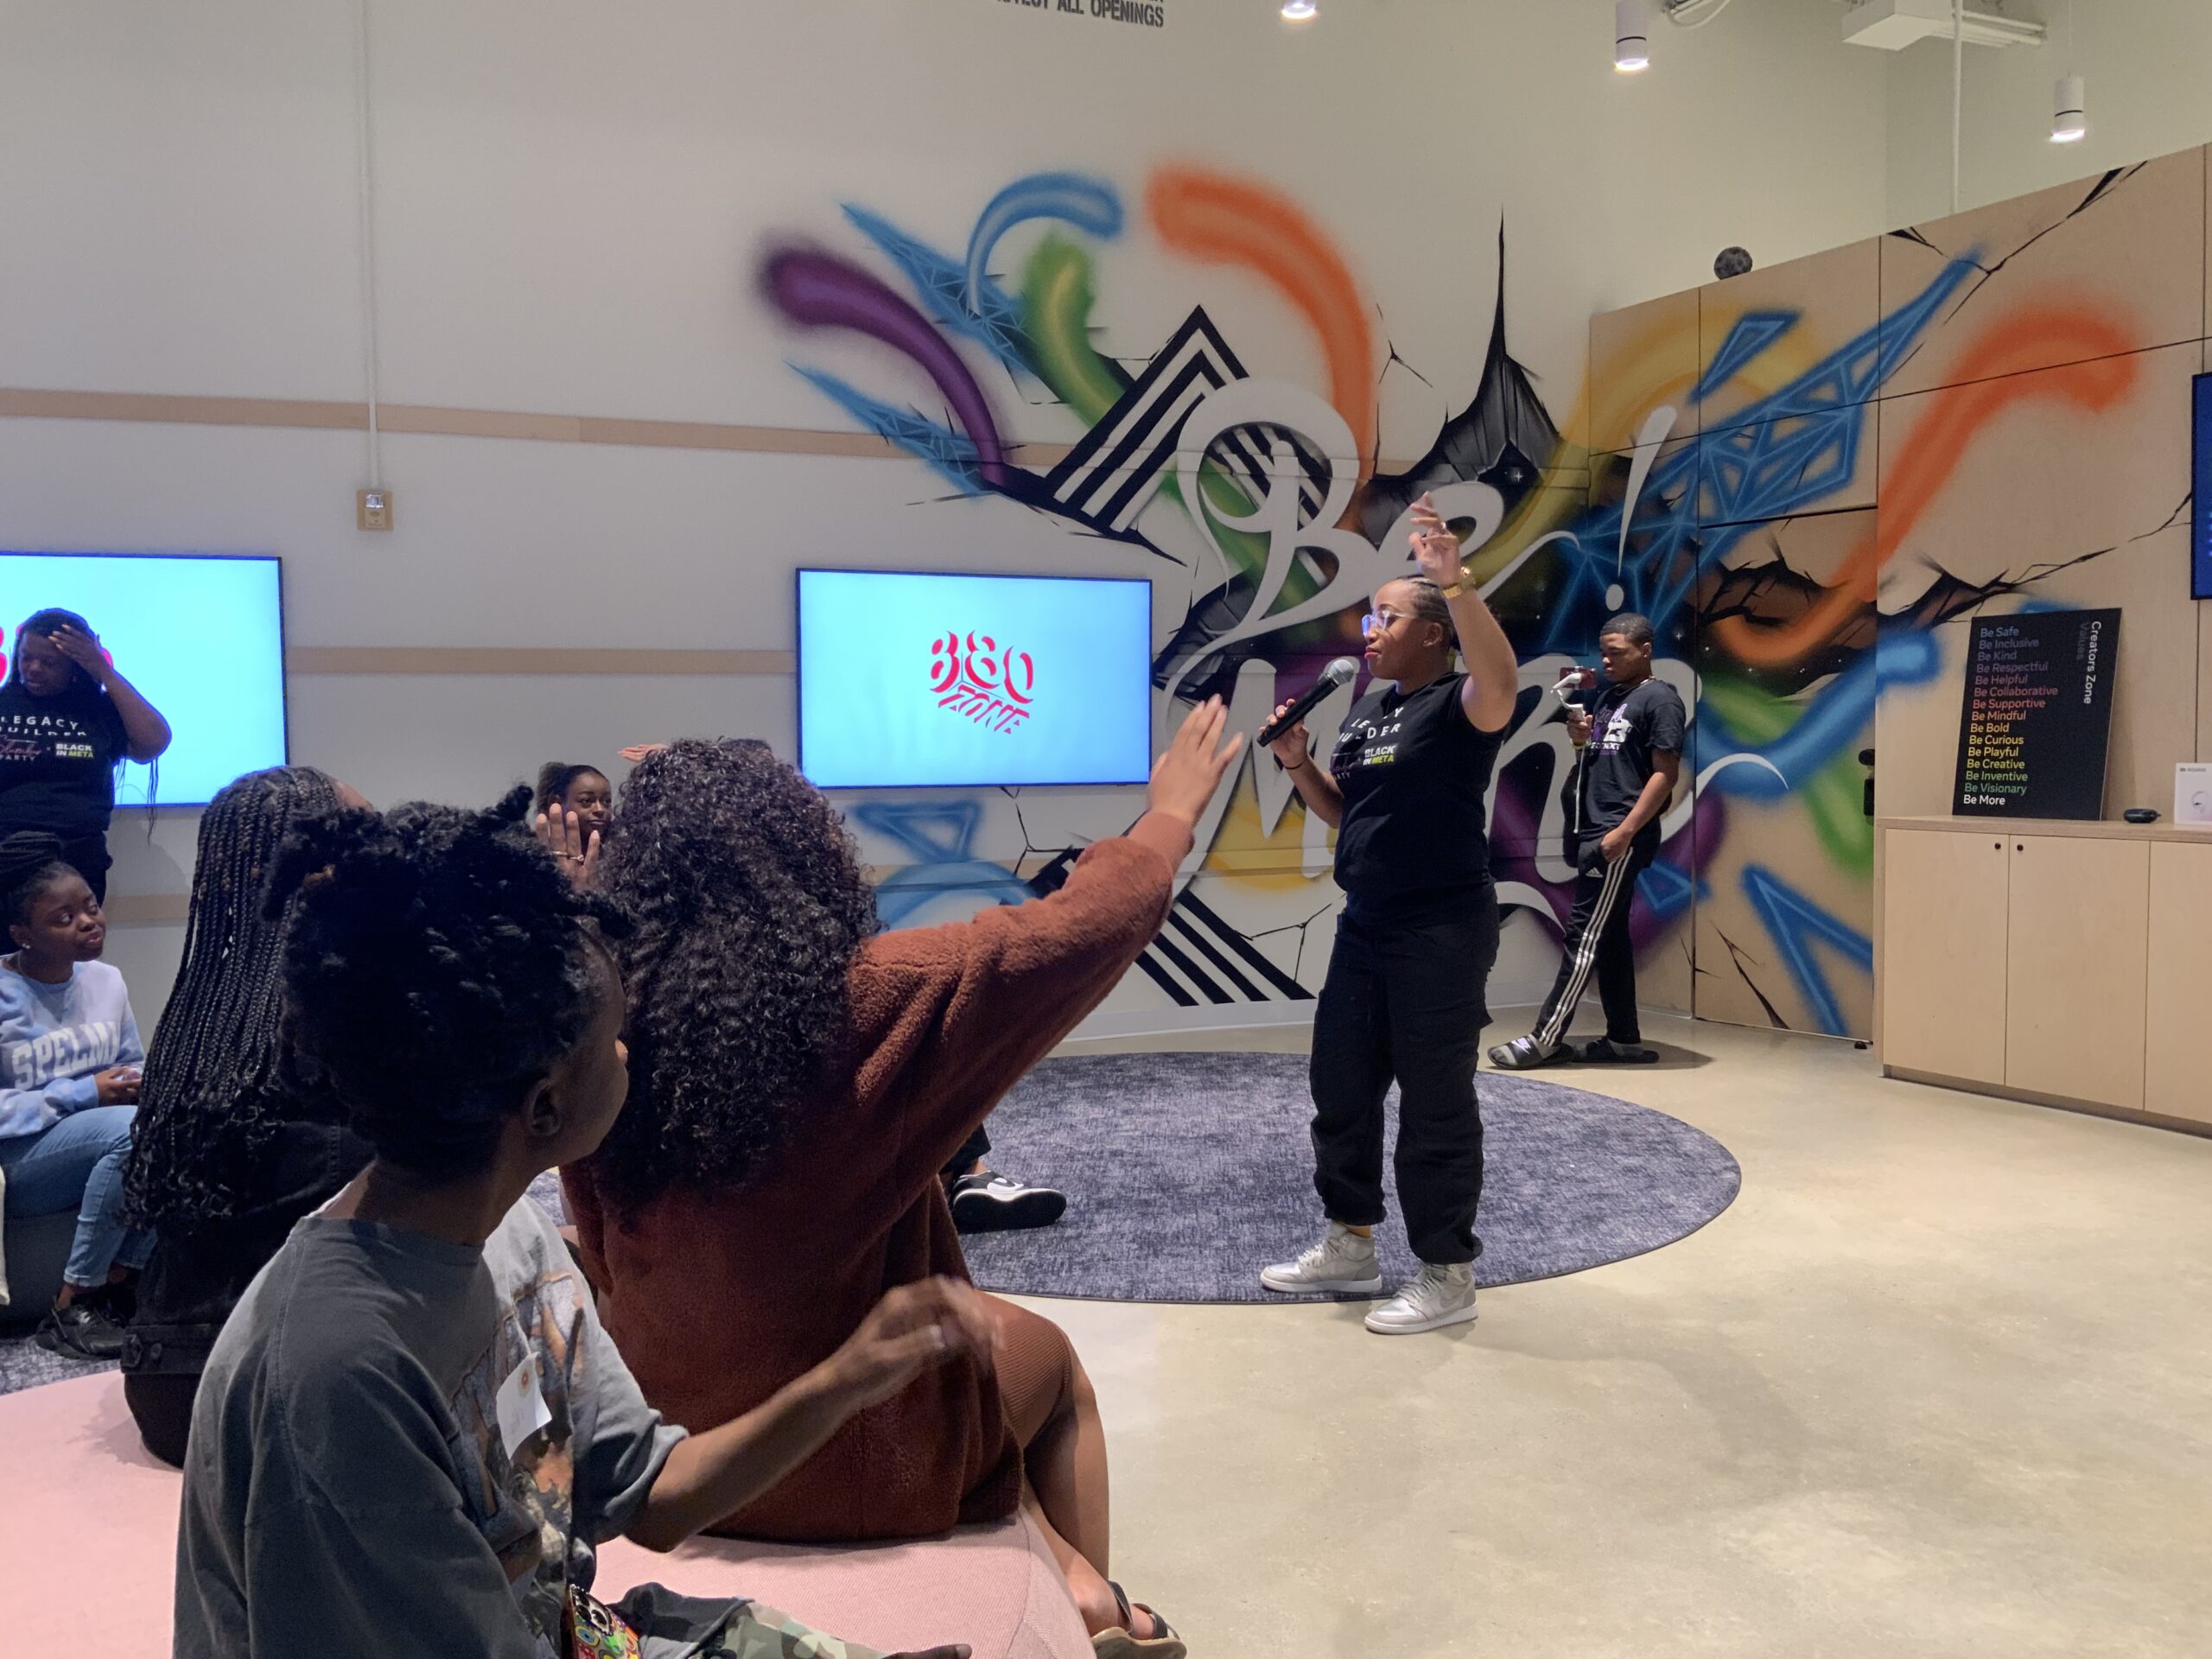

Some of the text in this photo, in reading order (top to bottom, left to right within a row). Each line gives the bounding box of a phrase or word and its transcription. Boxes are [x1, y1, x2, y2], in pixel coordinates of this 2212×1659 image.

[1057, 0, 1084, 15] ALL
[1090, 0, 1164, 28] OPENINGS
[1980, 626, 2019, 638] Be Safe
[1979, 638, 2039, 649] Be Inclusive
[1978, 651, 2017, 661] Be Kind
[1976, 662, 2048, 674] Be Respectful
[2083, 621, 2102, 704] Creators Zone
[1975, 674, 2028, 685] Be Helpful
[1974, 685, 2058, 696] Be Collaborative
[1973, 697, 2046, 710] Be Supportive
[1972, 710, 2026, 721] Be Mindful
[1, 715, 78, 730] LEGACY
[1970, 722, 2010, 733] Be Bold
[1969, 734, 2024, 745] Be Curious
[1364, 745, 1396, 758] BLACK
[1967, 747, 2018, 759] Be Playful
[1363, 757, 1372, 766] IN
[1372, 753, 1394, 764] META
[1967, 759, 2025, 769] Be Creative
[1966, 771, 2029, 781] Be Inventive
[1964, 783, 2027, 797] Be Visionary
[1963, 794, 2005, 805] Be More
